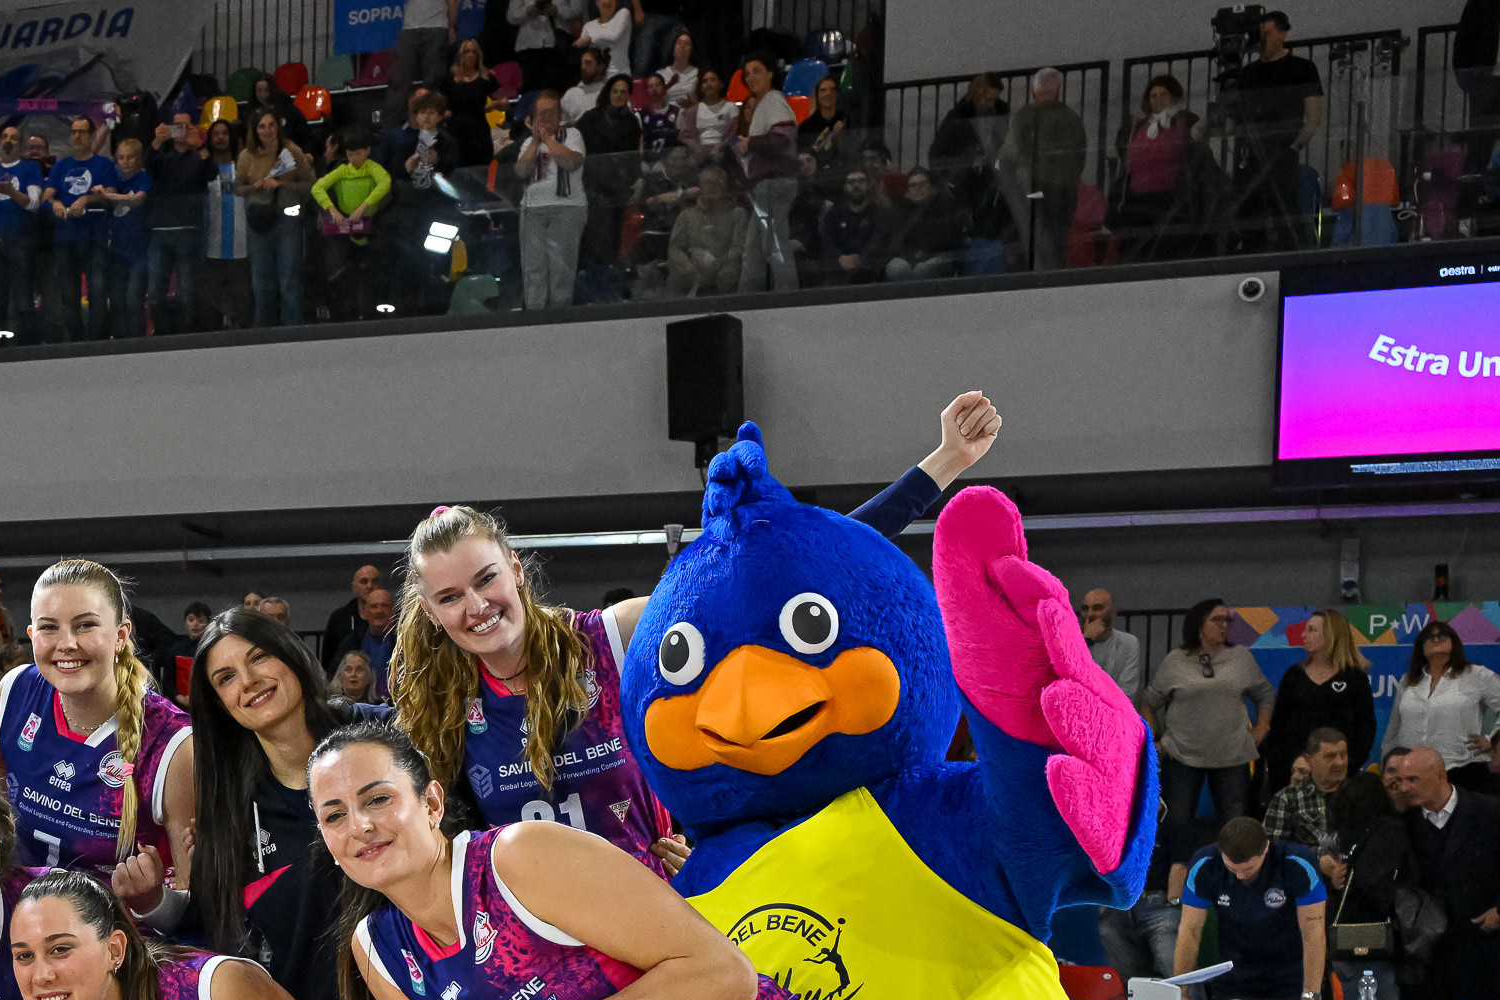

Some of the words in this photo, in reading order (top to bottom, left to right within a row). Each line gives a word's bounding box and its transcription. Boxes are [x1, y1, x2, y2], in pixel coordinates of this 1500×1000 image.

[1368, 334, 1450, 376] Estra
[498, 758, 532, 778] SAVI
[553, 752, 583, 767] DEL
[586, 737, 623, 761] BENE
[500, 781, 520, 792] Global
[563, 767, 600, 781] Forwarding
[600, 758, 627, 771] Company
[49, 774, 72, 793] errea
[18, 801, 33, 814] Global
[33, 808, 55, 823] Logistics
[65, 821, 95, 836] Forwarding
[22, 786, 62, 811] SAVINO
[63, 804, 86, 821] DEL
[33, 829, 61, 867] 7
[766, 914, 827, 947] BENE
